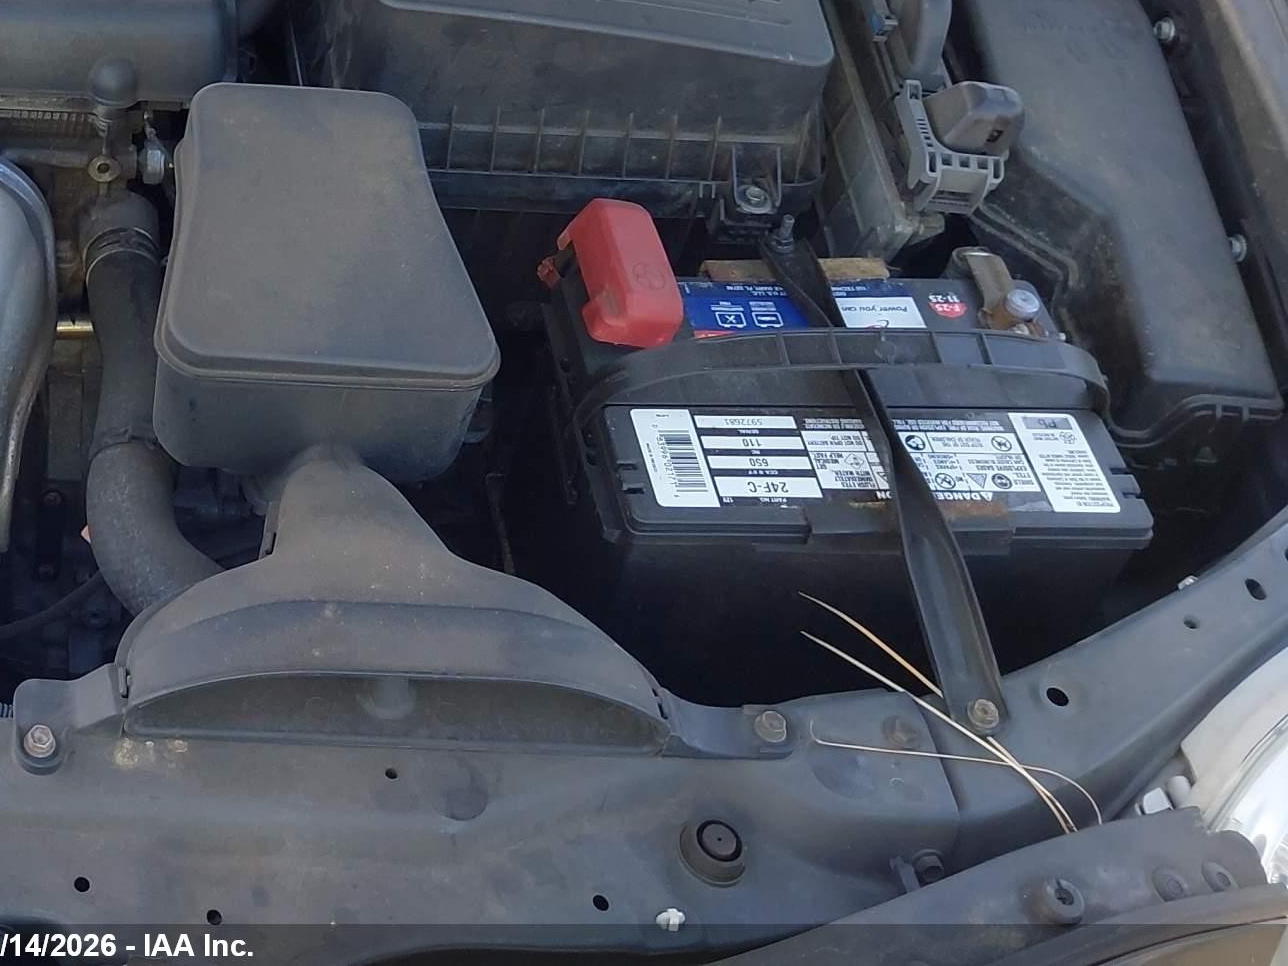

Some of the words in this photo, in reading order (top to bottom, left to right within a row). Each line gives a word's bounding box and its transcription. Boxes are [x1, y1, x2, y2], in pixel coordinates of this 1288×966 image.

[742, 438, 762, 447] 110
[749, 458, 768, 467] 650
[747, 481, 788, 493] 24F-C
